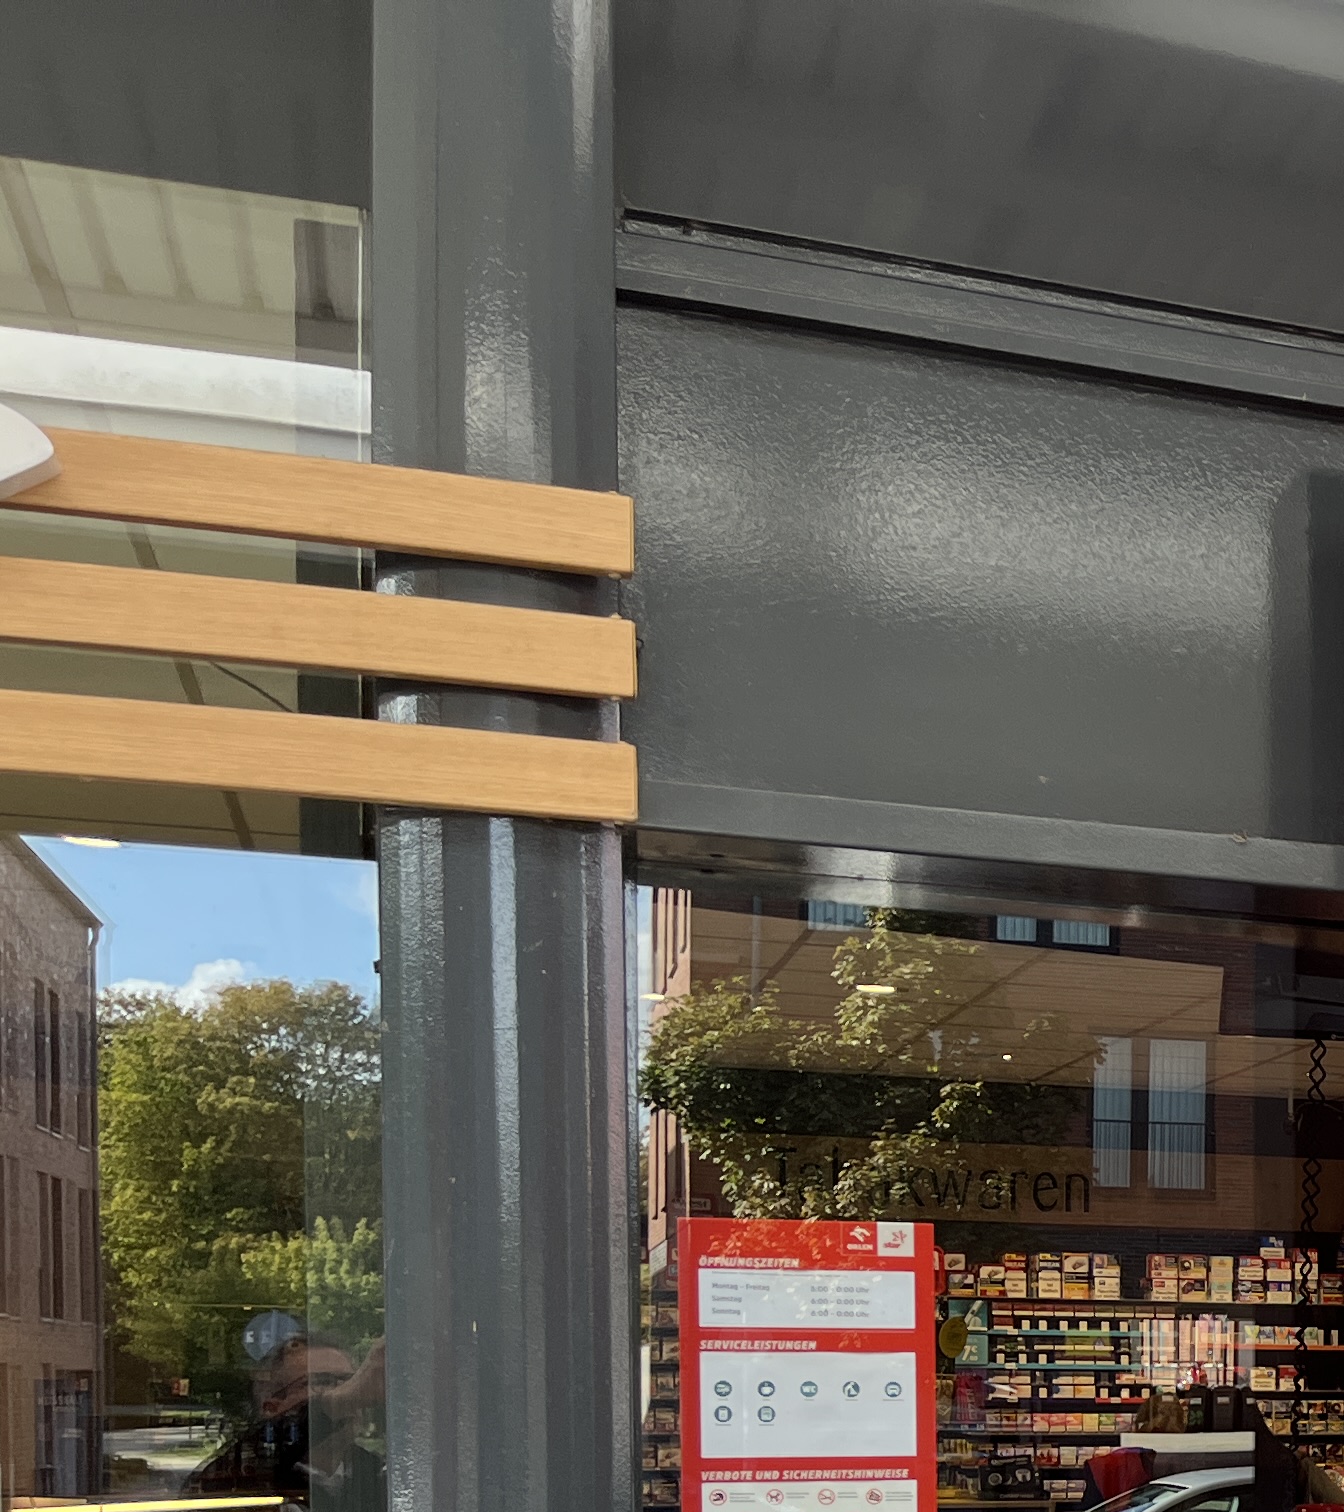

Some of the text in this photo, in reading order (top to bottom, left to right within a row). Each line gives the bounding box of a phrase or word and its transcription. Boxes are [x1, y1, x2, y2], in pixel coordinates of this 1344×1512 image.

[699, 1340, 817, 1351] SERVICELEISTUNGEN
[701, 1471, 752, 1481] VERBOTE
[756, 1470, 779, 1480] UND
